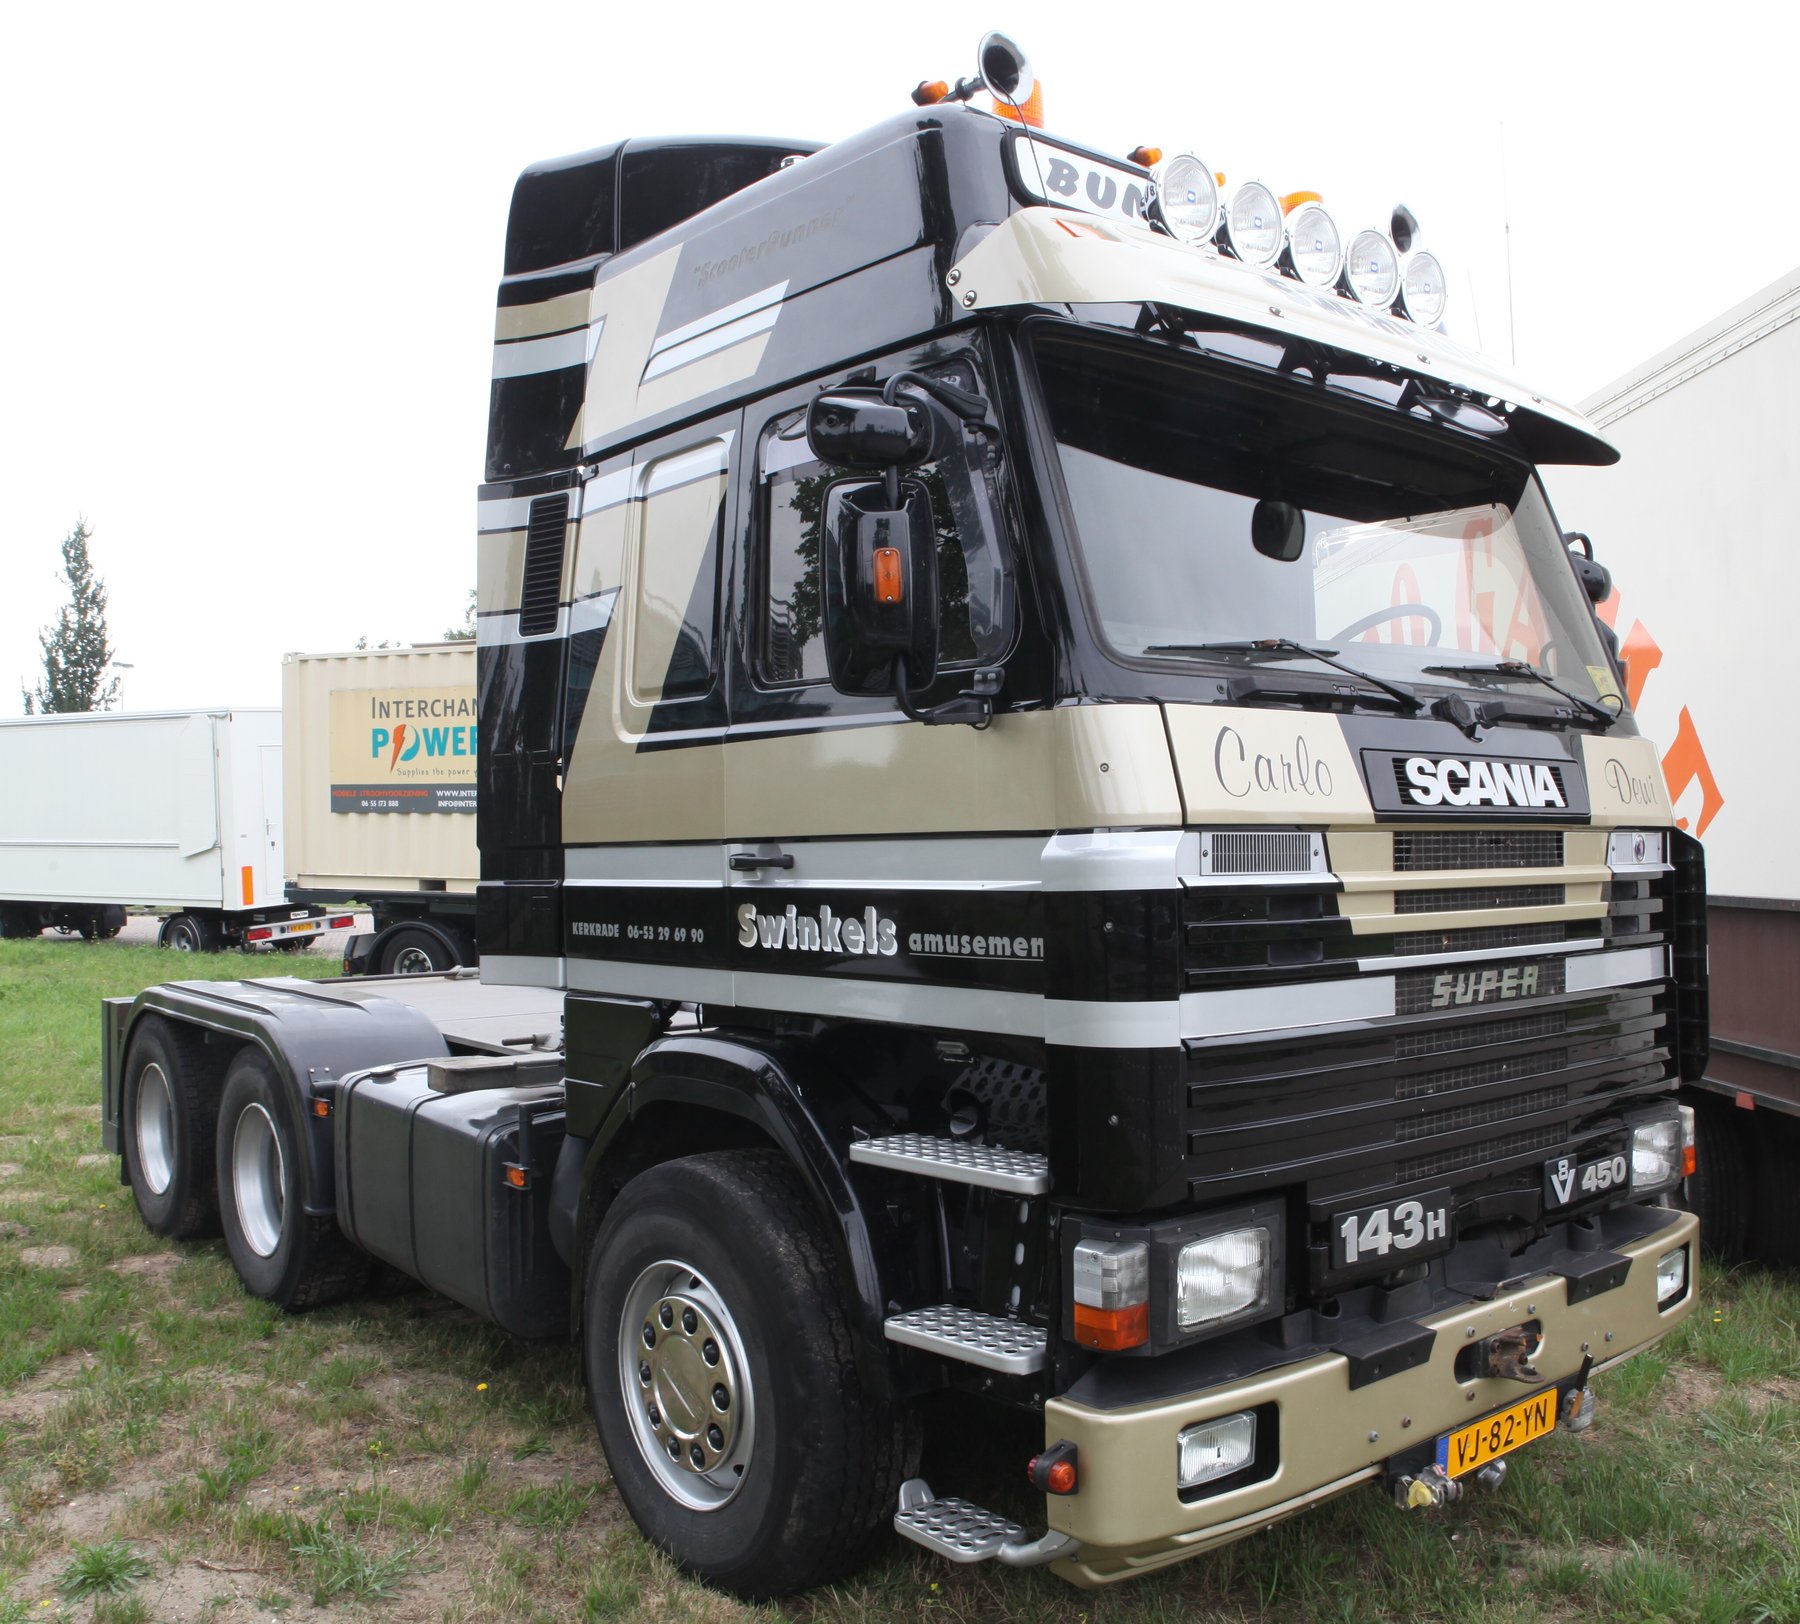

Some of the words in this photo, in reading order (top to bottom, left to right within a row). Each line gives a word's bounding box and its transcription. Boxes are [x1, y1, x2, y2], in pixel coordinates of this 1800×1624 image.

[396, 767, 429, 778] Supplies
[432, 767, 443, 776] the
[447, 768, 470, 778] power
[1214, 726, 1334, 798] Carlo
[1405, 757, 1566, 808] SCANIA
[572, 922, 620, 938] KERKRADE
[627, 925, 654, 940] 06-53
[658, 926, 670, 940] 29
[674, 927, 686, 942] 69
[691, 928, 704, 943] 90
[737, 903, 898, 956] Swinkels
[1431, 966, 1539, 1007] SUPER
[1581, 1156, 1627, 1193] 450
[1457, 1399, 1548, 1467] VJ-82-YN
